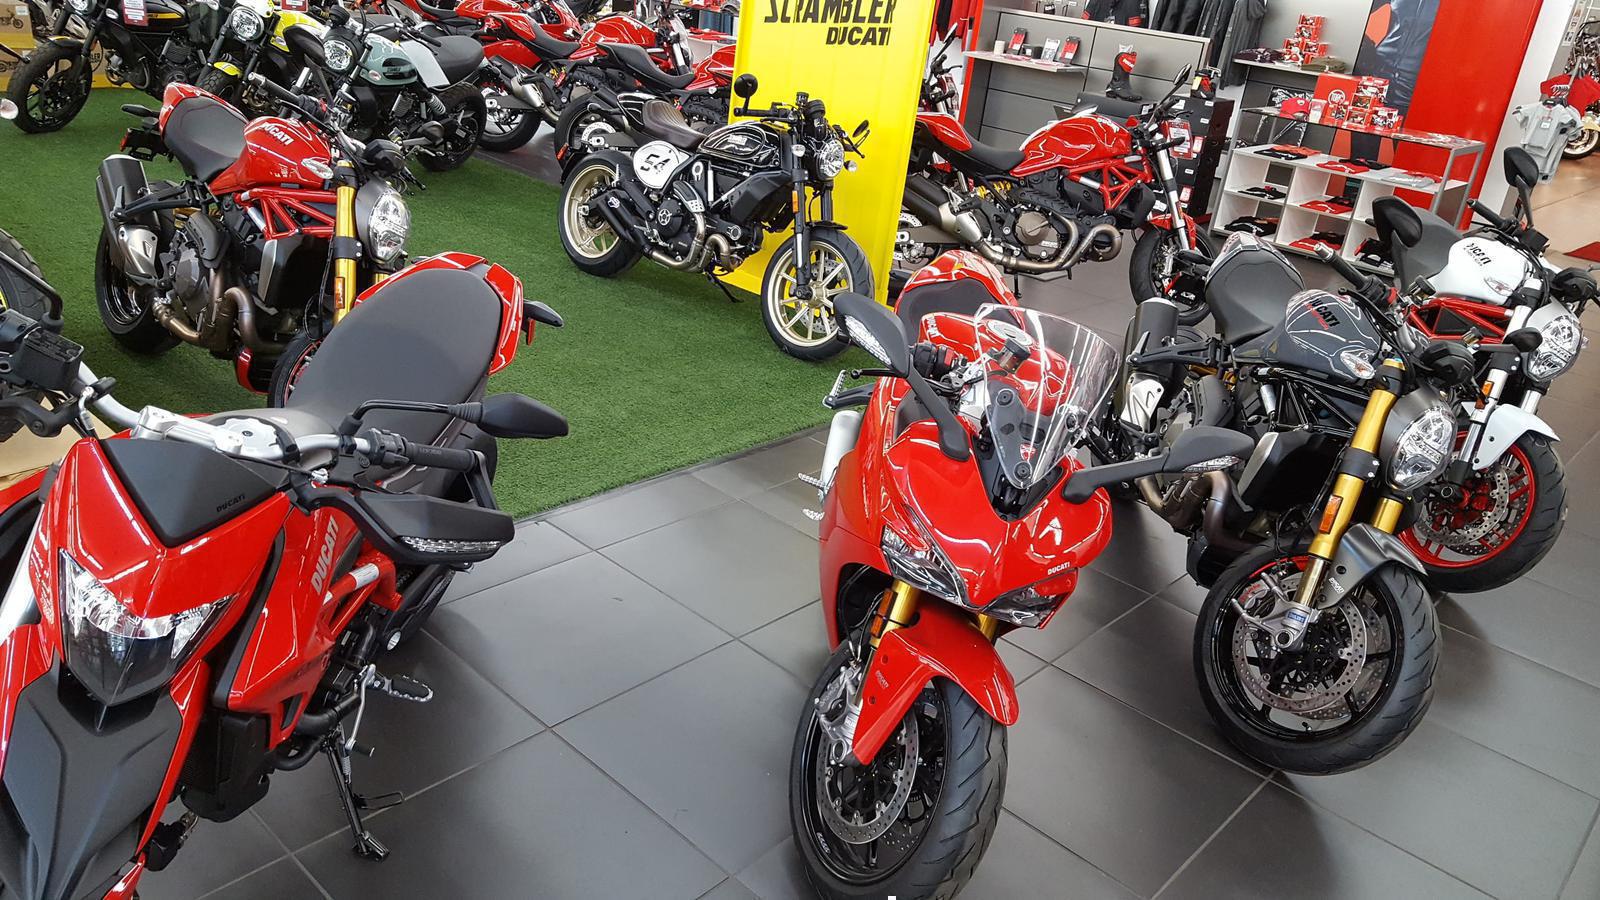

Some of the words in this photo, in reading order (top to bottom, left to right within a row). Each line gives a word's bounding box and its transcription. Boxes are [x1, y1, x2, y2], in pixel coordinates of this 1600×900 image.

[826, 27, 891, 45] DUCATI
[216, 495, 246, 512] DUCATI
[311, 515, 338, 595] DUCATI
[1047, 561, 1070, 575] DUCATI
